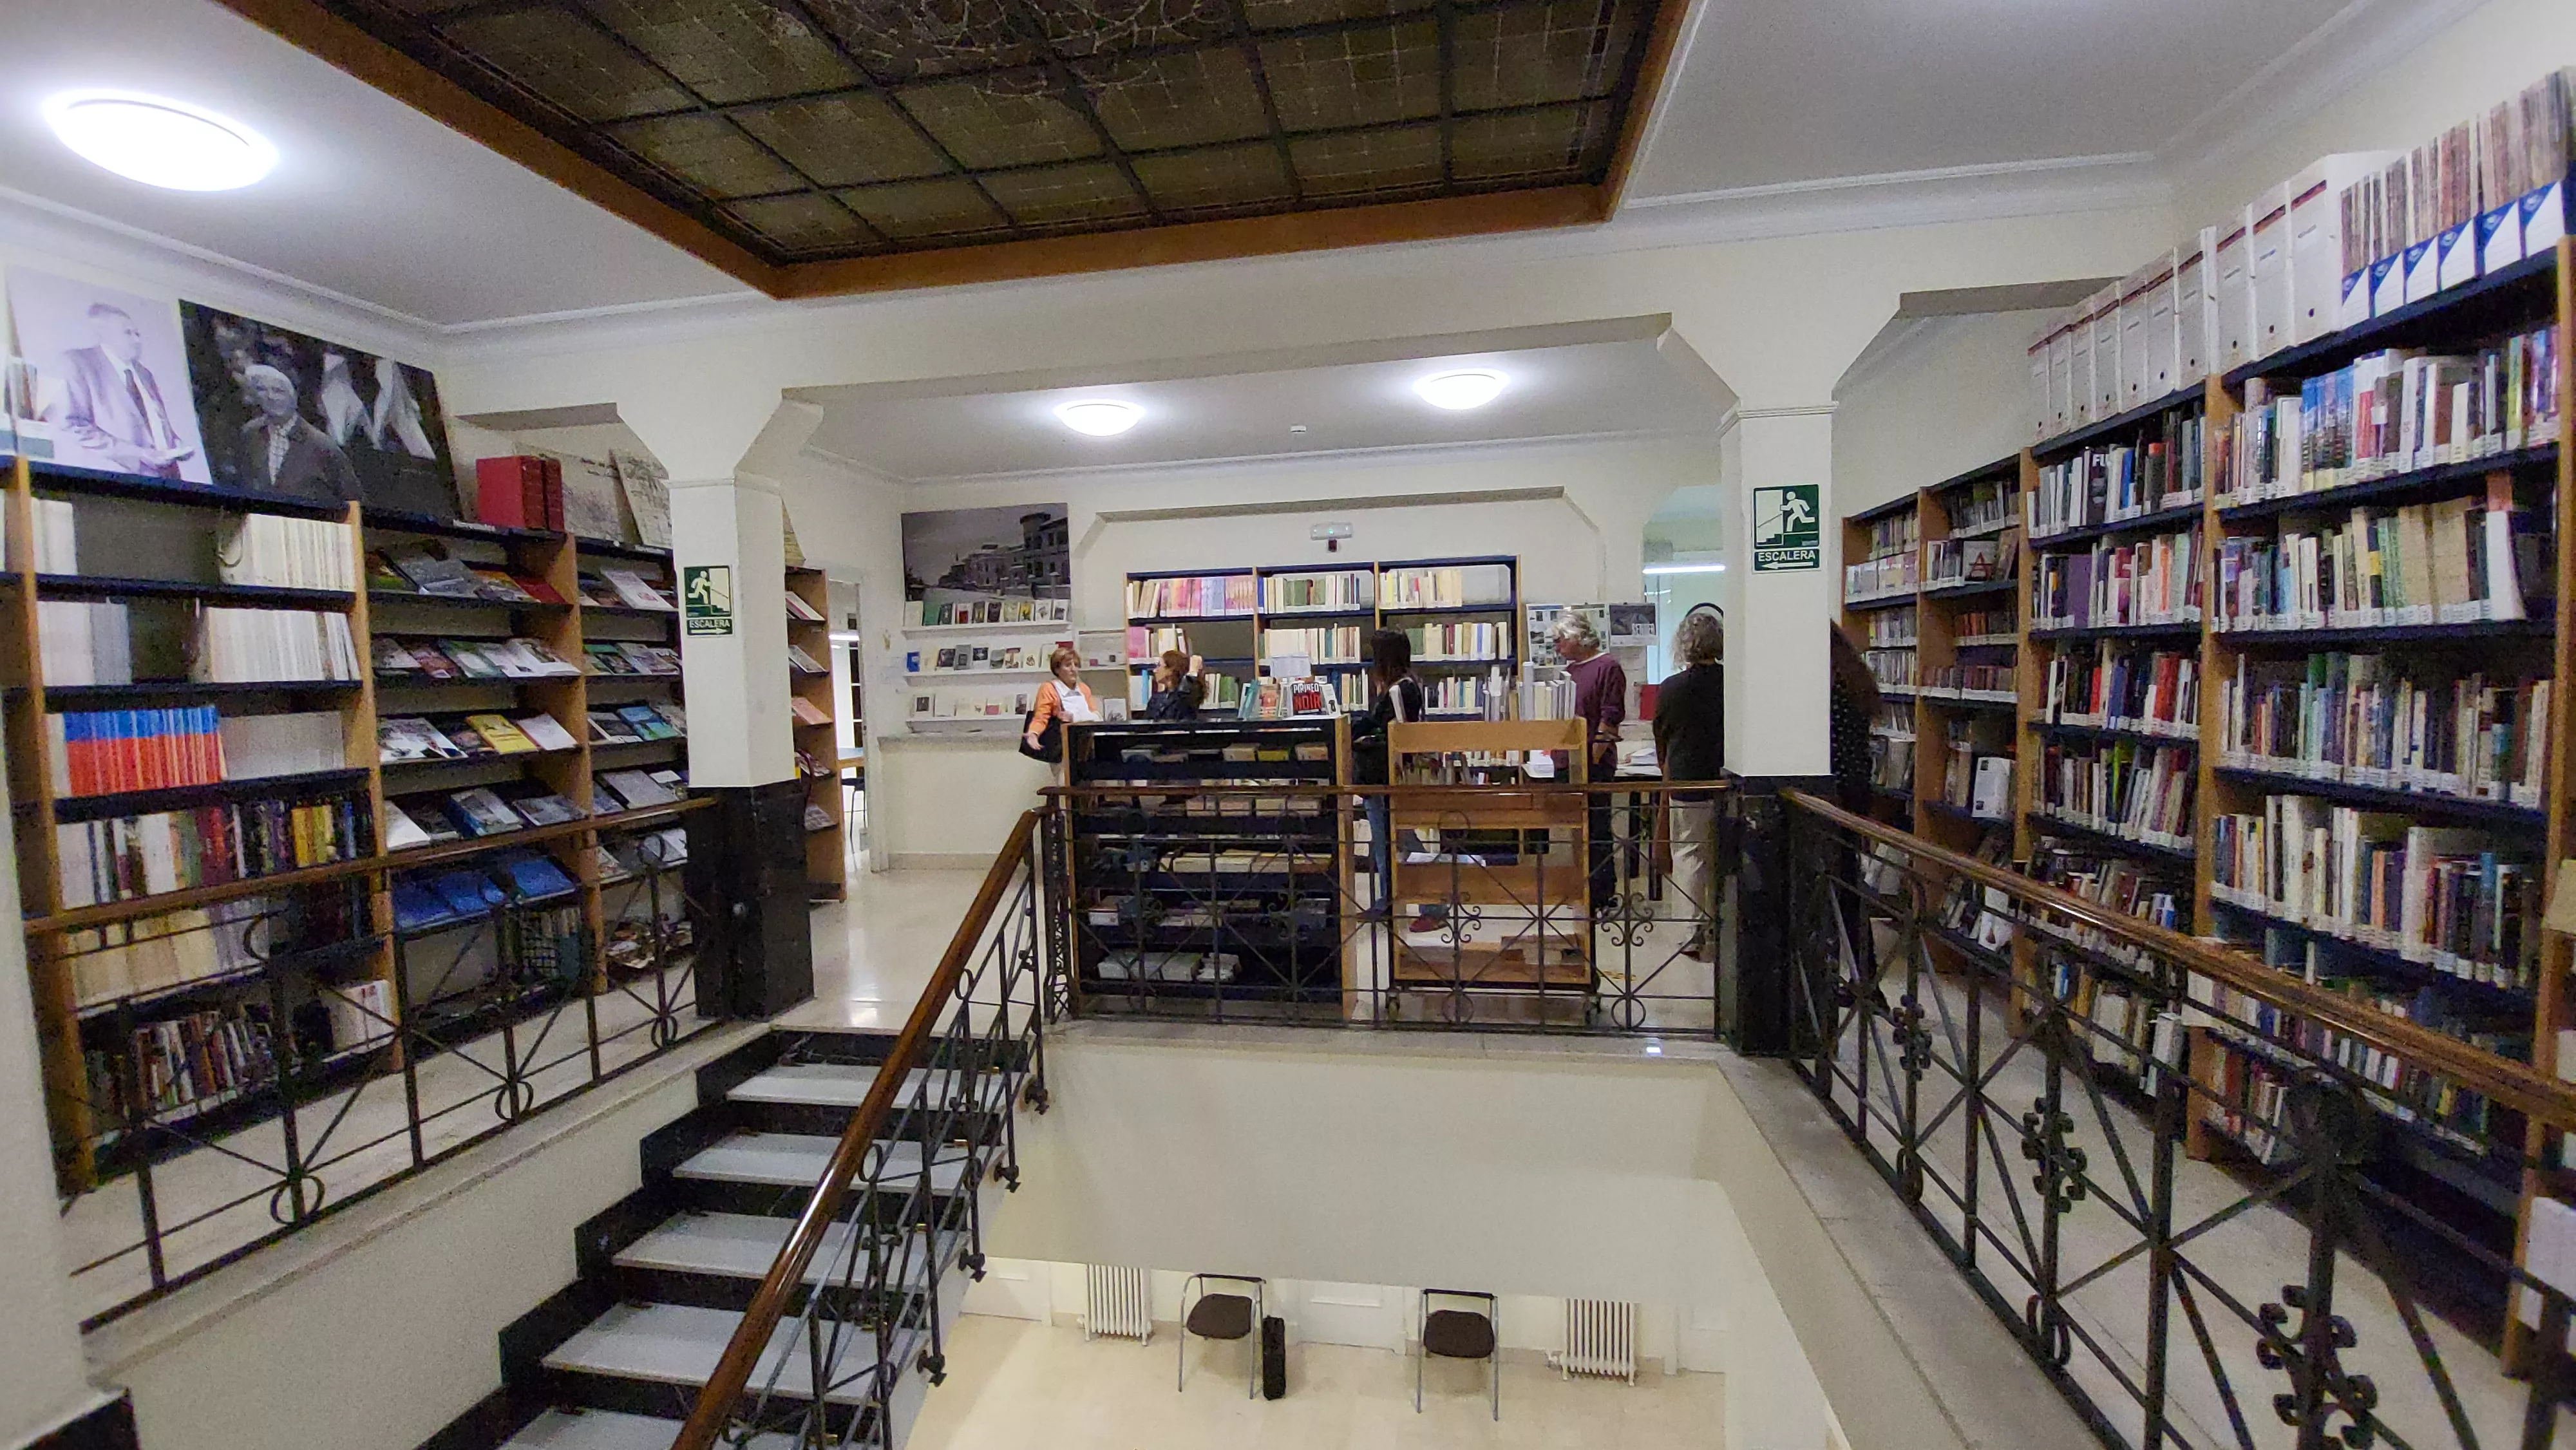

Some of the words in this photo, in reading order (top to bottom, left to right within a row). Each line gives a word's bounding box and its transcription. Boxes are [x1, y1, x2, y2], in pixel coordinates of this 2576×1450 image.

[1758, 551, 1815, 561] ESCALERA
[689, 619, 730, 628] ESCALERA
[1293, 683, 1320, 693] PIRINEO
[1294, 695, 1320, 710] NOIR
